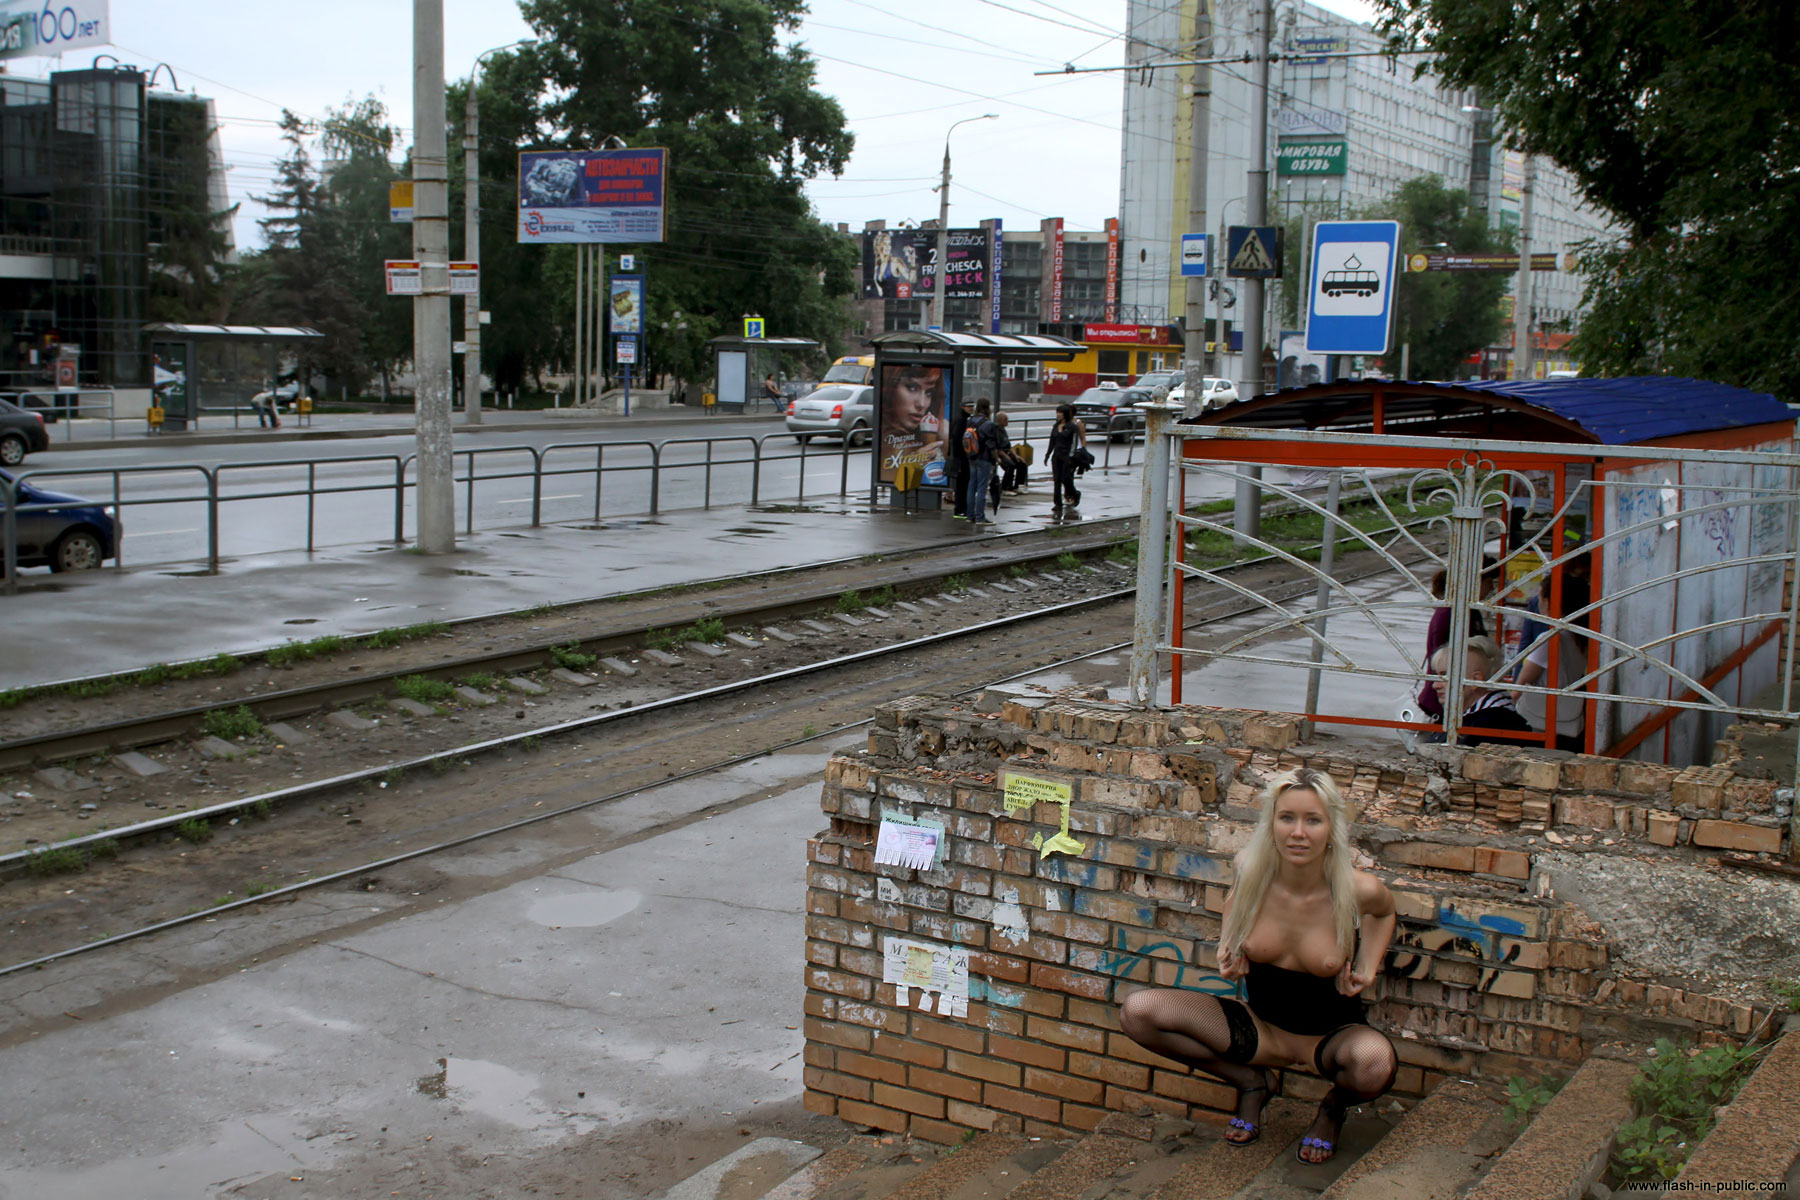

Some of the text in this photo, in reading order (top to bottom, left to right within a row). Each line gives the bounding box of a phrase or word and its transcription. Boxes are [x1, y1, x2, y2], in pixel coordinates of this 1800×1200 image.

[1281, 145, 1342, 158] МИРОВАЯ
[1291, 159, 1330, 171] ОБУВЬ
[540, 224, 574, 232] EXIST.RU
[890, 943, 967, 968] МСАЖ
